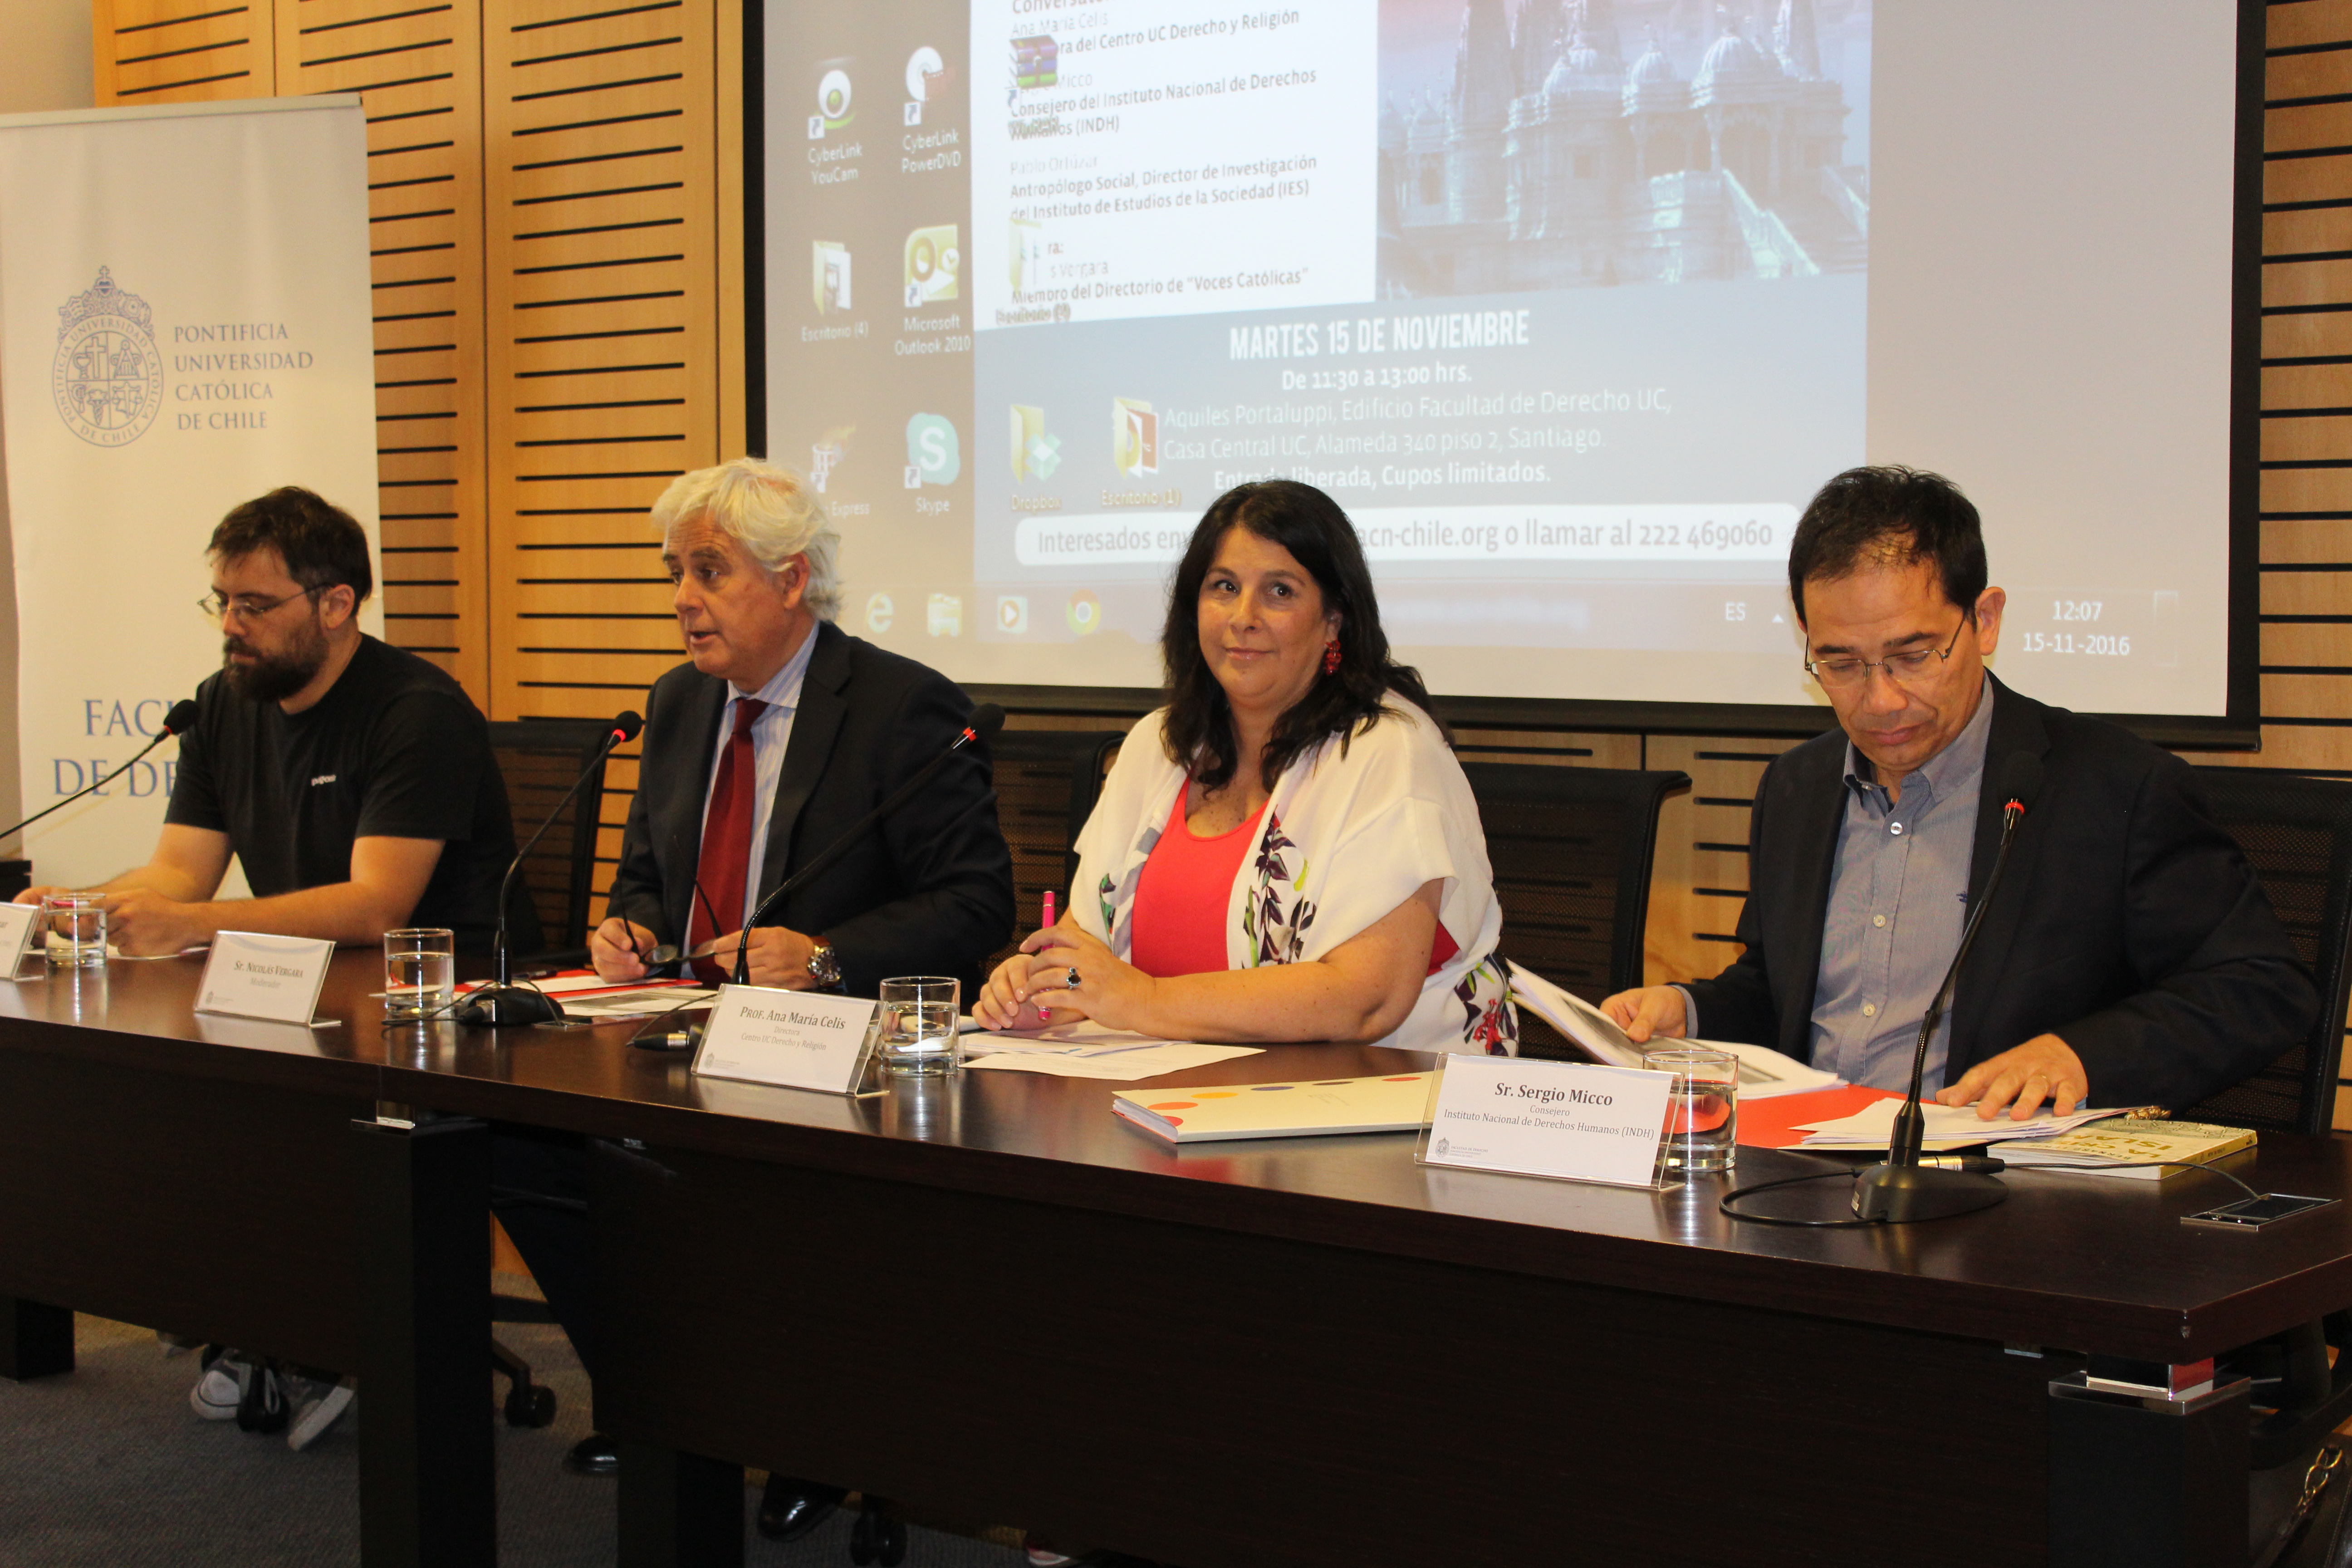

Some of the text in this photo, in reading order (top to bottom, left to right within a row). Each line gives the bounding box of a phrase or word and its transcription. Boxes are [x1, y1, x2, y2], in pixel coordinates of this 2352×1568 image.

[1076, 35, 1096, 52] del
[1100, 32, 1144, 49] Centro
[1148, 26, 1166, 42] UC
[1170, 19, 1226, 40] Derecho
[1230, 19, 1238, 35] y
[1242, 9, 1299, 30] Religión
[1080, 94, 1100, 110] del
[1103, 88, 1161, 108] Instituto
[1166, 78, 1226, 100] Nacional
[1230, 76, 1246, 92] de
[1250, 68, 1317, 90] Derechos
[1076, 115, 1120, 137] (INDH)
[902, 128, 959, 153] CyberLink
[808, 142, 862, 167] CyberLink
[902, 151, 961, 174] PowerDVD
[810, 167, 858, 185] YouCam
[1011, 154, 1317, 199] Antropólogo Social, Director de Investigación
[1011, 178, 1309, 220] del Instituto de Estudios de la Sociedad (IES)
[1072, 284, 1091, 299] del
[1096, 277, 1163, 298] Directorio
[1167, 277, 1183, 294] de
[174, 323, 289, 343] PONTIFICIA
[903, 314, 960, 332] Microsoft
[895, 335, 971, 356] Outlook 2010
[1230, 310, 1530, 360] MARTES 15 DE NOVIEMBRE
[175, 352, 314, 372] UNIVERSIDAD
[1282, 361, 1473, 392] De 11:30 a 13:00 hrs.
[176, 379, 274, 401] CATÓLICA
[1164, 387, 1672, 431] Aquiles Portaluppi, Edificio Facultad de Derecho UC,
[177, 411, 268, 431] DE CHILE
[1164, 425, 1607, 460] Casa Central UC, Alameda 340 piso 2, Santiago.
[1292, 465, 1377, 491] liberada,
[1382, 465, 1443, 490] Cupos
[1448, 460, 1551, 485] limitados.
[915, 496, 951, 516] Skype
[1011, 494, 1062, 514] Dropbox
[1101, 487, 1182, 508] Escritorio (1)
[832, 500, 870, 519] Express
[1038, 525, 1152, 554] Interesados
[1505, 524, 1519, 545] o
[1525, 518, 1604, 546] llamar
[1610, 518, 1633, 546] al
[1639, 524, 1680, 546] 222
[1687, 519, 1773, 550] 469060
[1725, 602, 1746, 622] ES
[2052, 600, 2102, 622] 12:07
[2023, 632, 2131, 657] 15-11-2016
[53, 758, 110, 796] DE
[766, 1009, 786, 1022] Ana
[787, 1012, 818, 1026] María
[820, 1016, 846, 1030] Celis
[741, 1032, 826, 1051] Centro UC Derecho y Religión
[774, 1026, 800, 1036] Directora
[1494, 1082, 1613, 1106] Sr. Sergio Micco
[1529, 1104, 1570, 1117] Consejero
[1443, 1108, 1654, 1141] Instituto Nacional de Derechos Humanos (INDH)
